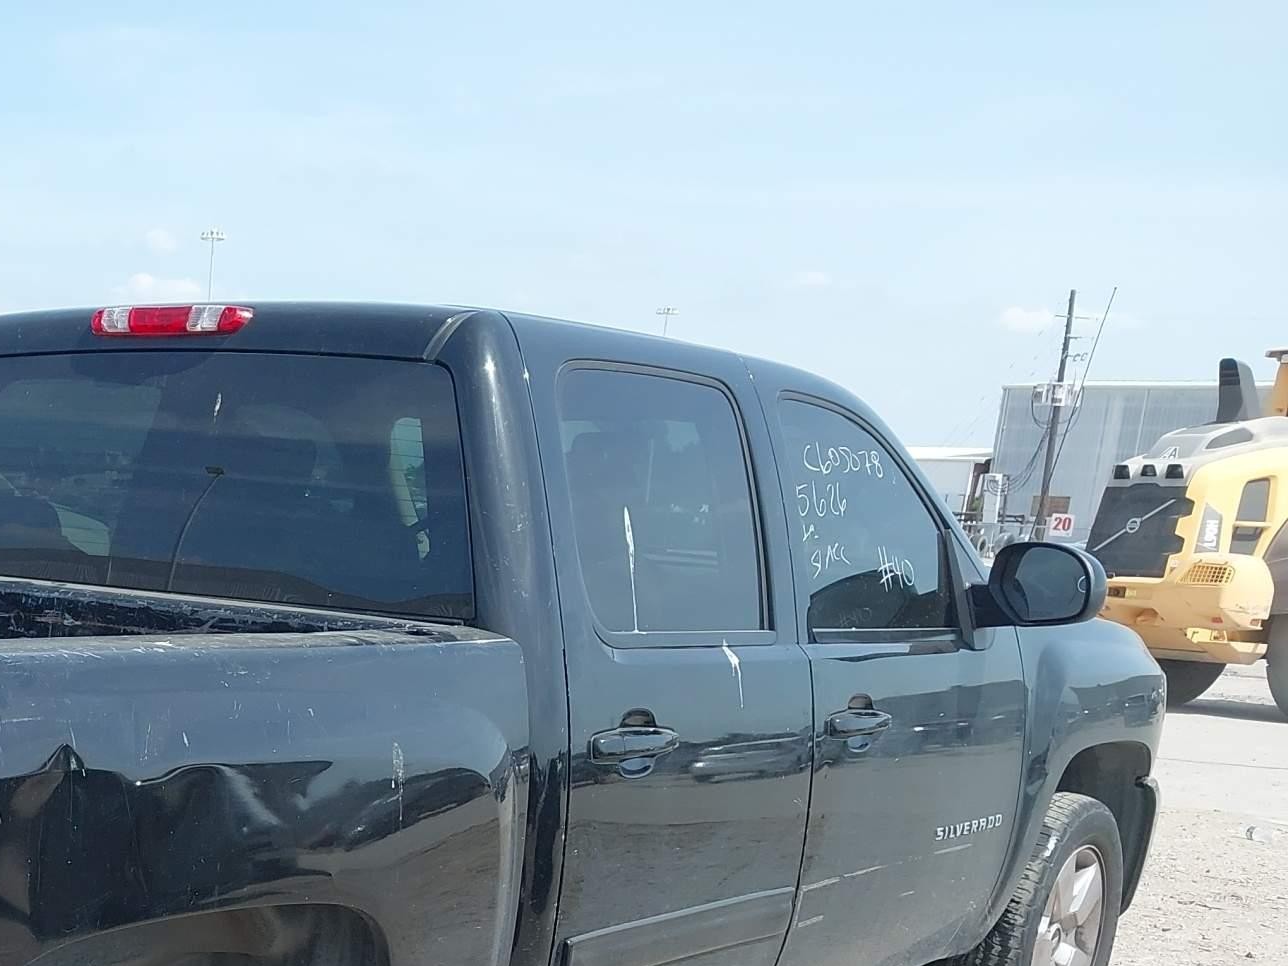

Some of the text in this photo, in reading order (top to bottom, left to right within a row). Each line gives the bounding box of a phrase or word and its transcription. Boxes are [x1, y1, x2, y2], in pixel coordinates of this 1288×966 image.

[795, 479, 848, 517] 5626
[1052, 516, 1072, 532] 20
[876, 546, 915, 593] #40
[935, 813, 1004, 841] SILVERADO
